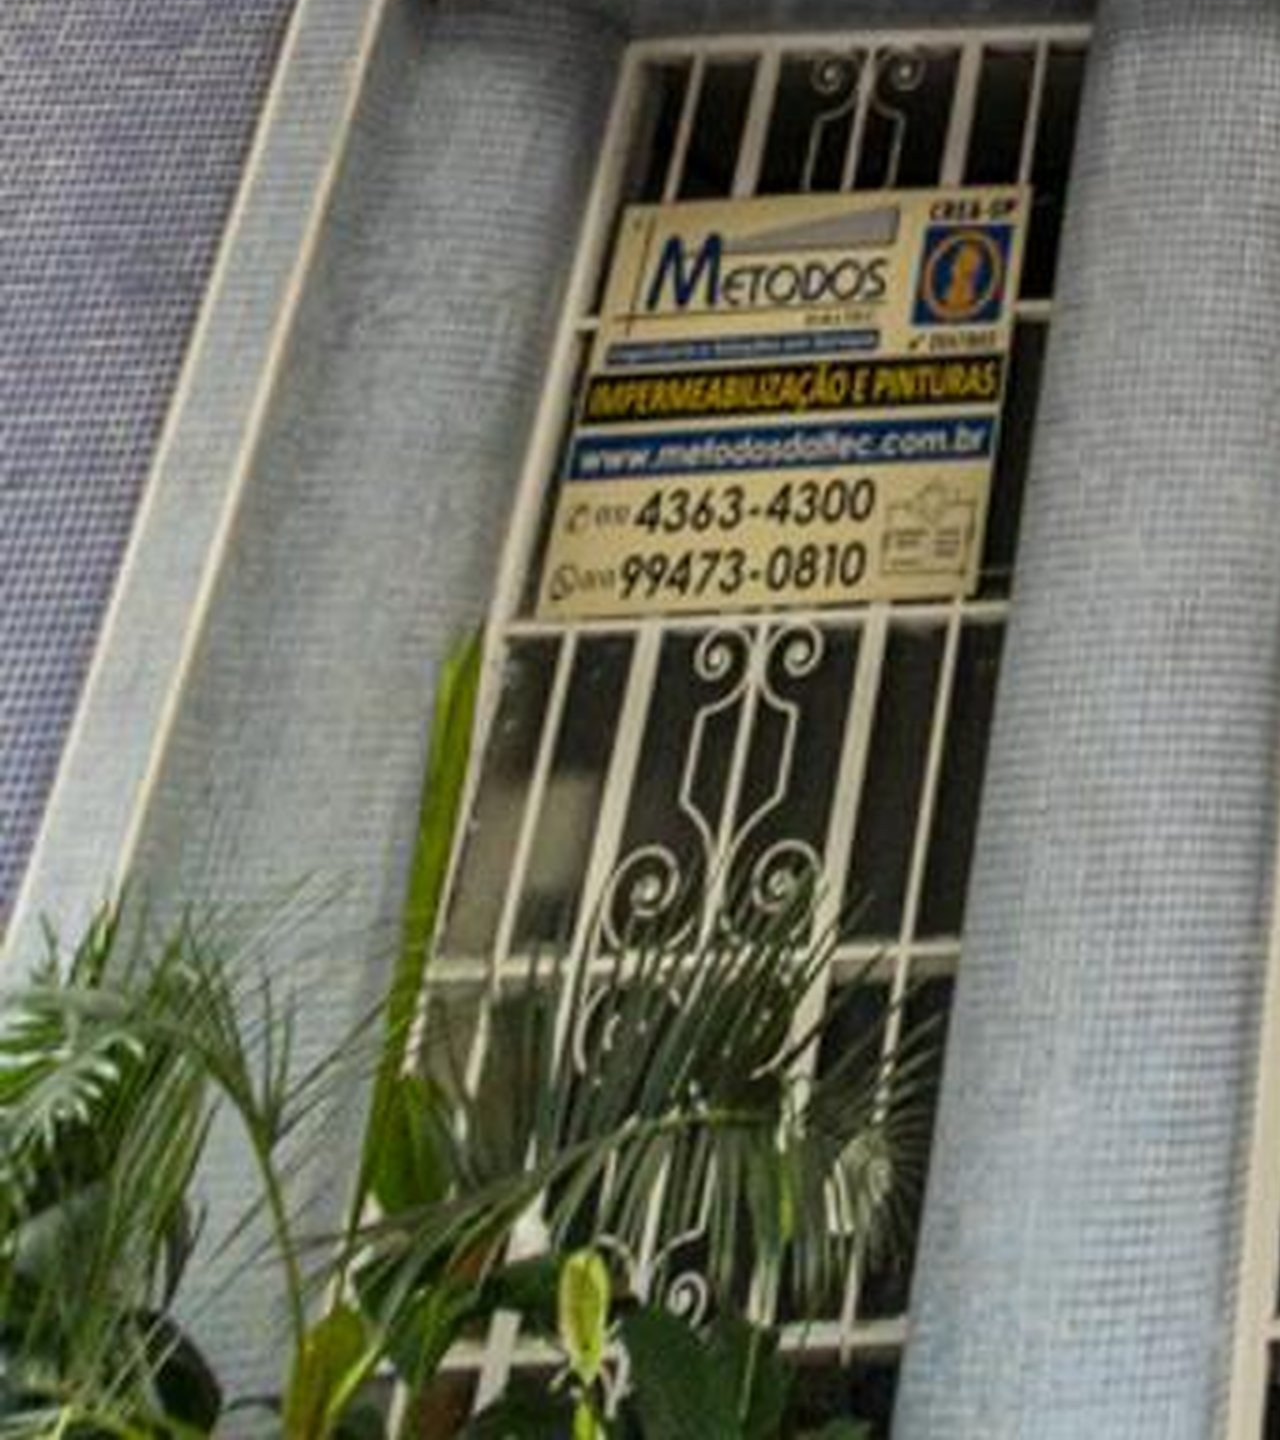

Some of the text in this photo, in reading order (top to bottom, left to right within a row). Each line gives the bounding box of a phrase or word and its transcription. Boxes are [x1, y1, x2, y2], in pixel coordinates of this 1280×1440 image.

[645, 233, 889, 311] METODOS
[588, 360, 997, 417] IMPERMEABILIZAÇÃO E PINTURAS
[634, 478, 876, 534] 4363-4300
[618, 540, 868, 600] 99473-0810
